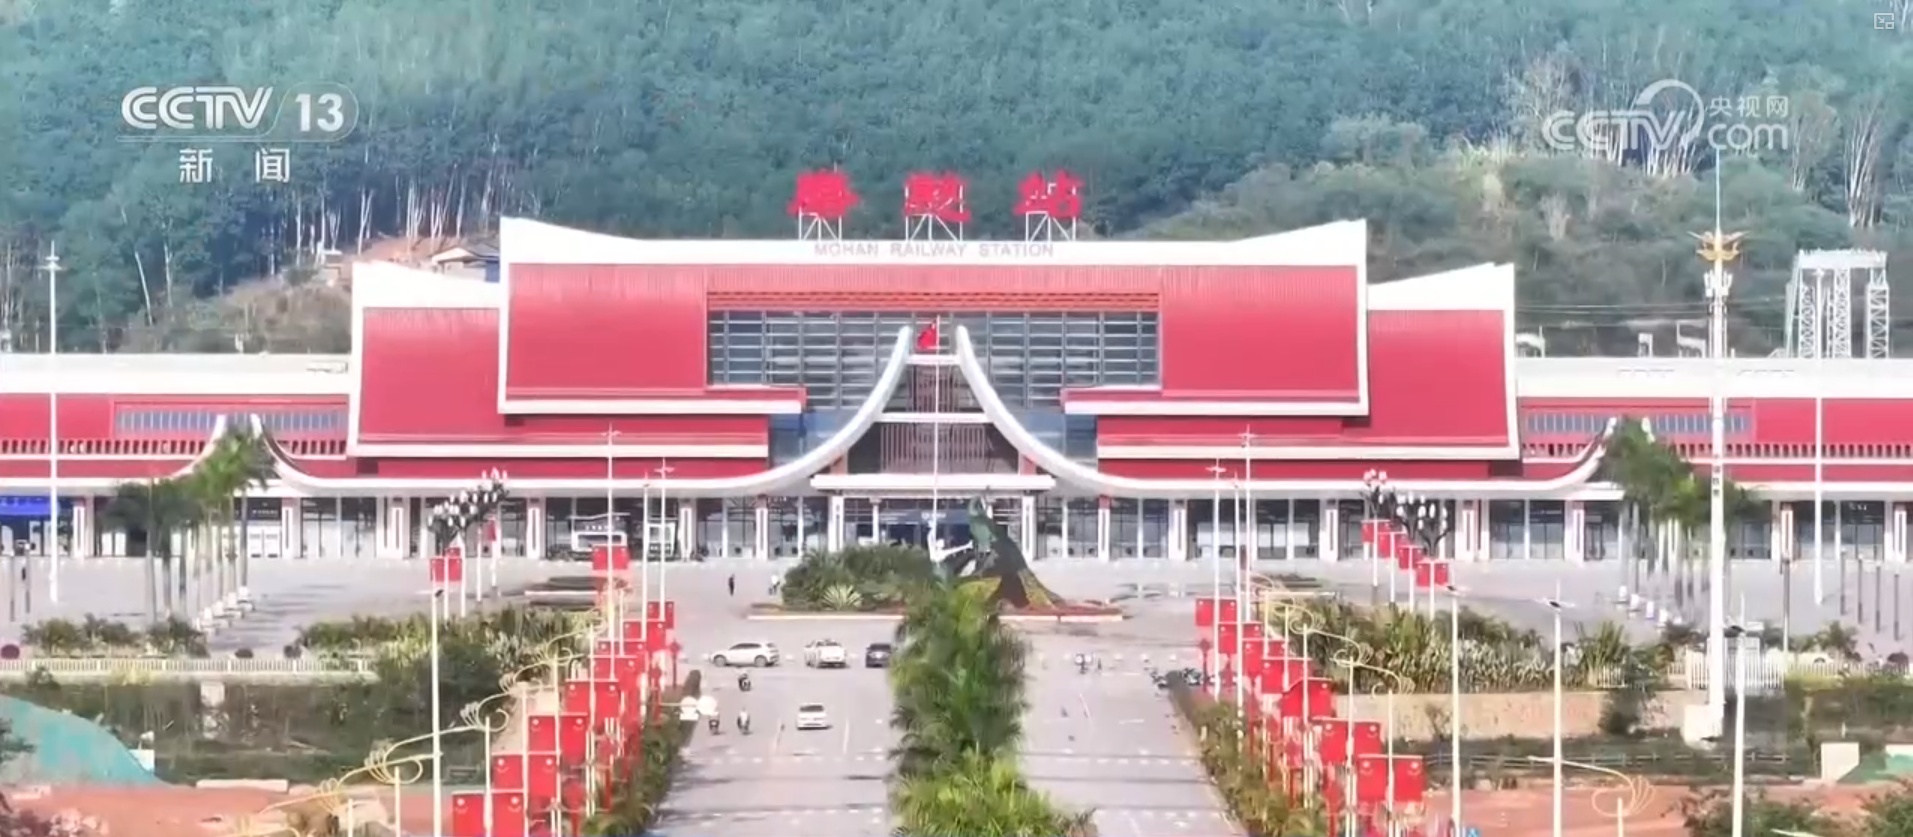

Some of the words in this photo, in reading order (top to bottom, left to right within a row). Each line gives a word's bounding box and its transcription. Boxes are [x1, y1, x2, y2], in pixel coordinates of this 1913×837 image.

[814, 243, 879, 258] MOHAN
[889, 243, 967, 258] RAILWAY
[978, 243, 1054, 258] STATION
